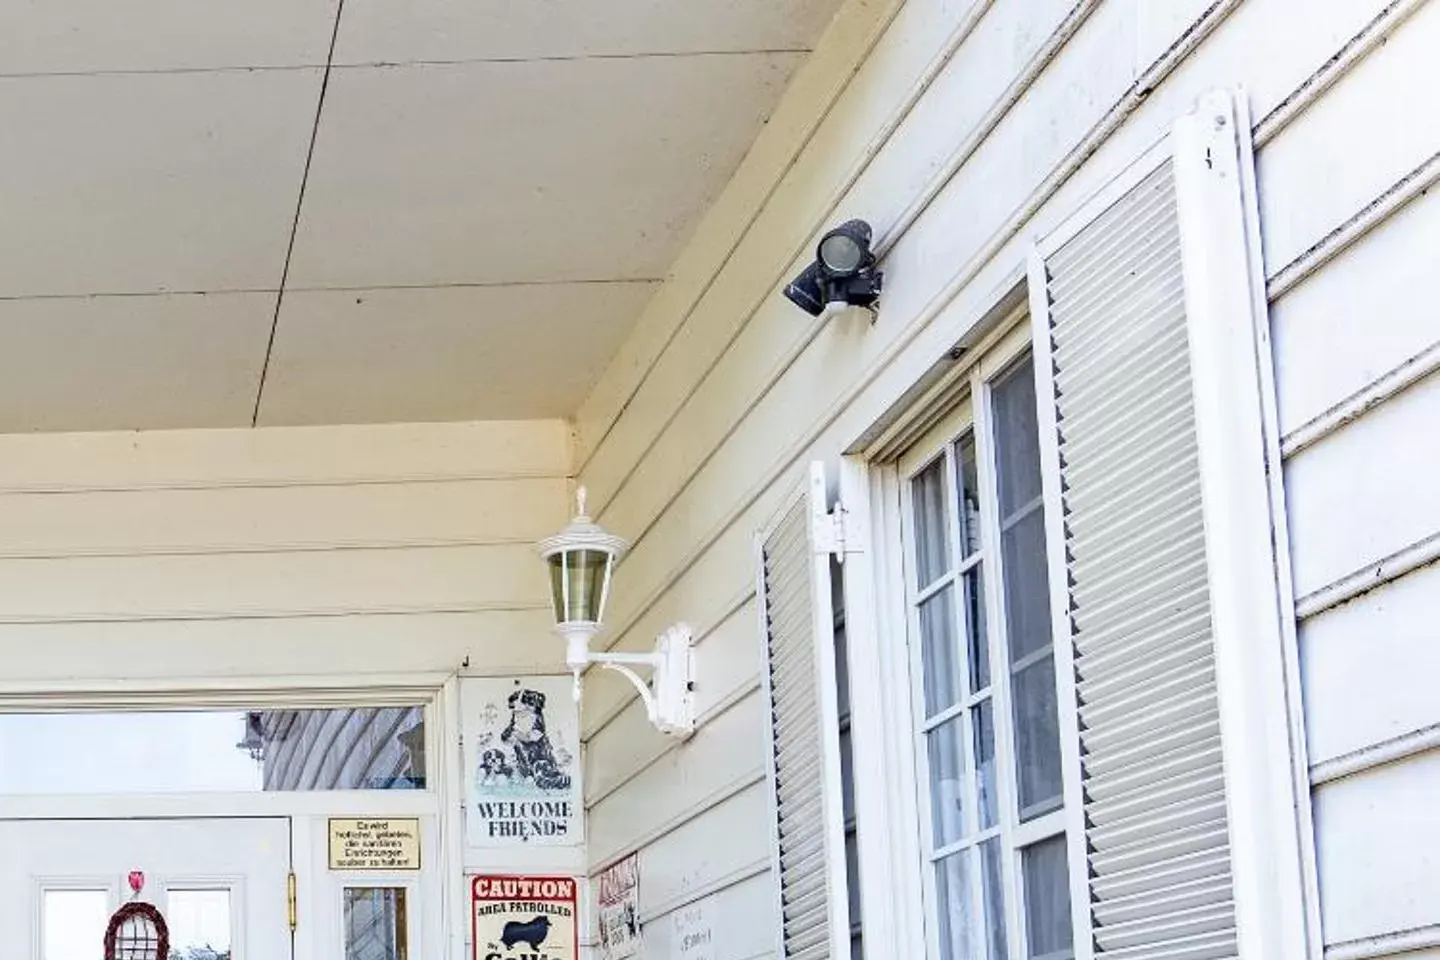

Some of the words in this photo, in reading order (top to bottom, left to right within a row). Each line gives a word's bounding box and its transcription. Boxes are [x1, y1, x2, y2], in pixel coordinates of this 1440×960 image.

[478, 802, 573, 818] WELCOME
[489, 821, 567, 836] FRIENDS
[475, 880, 573, 898] CAUTION
[478, 902, 506, 916] AREA
[509, 901, 571, 916] PATROLLED
